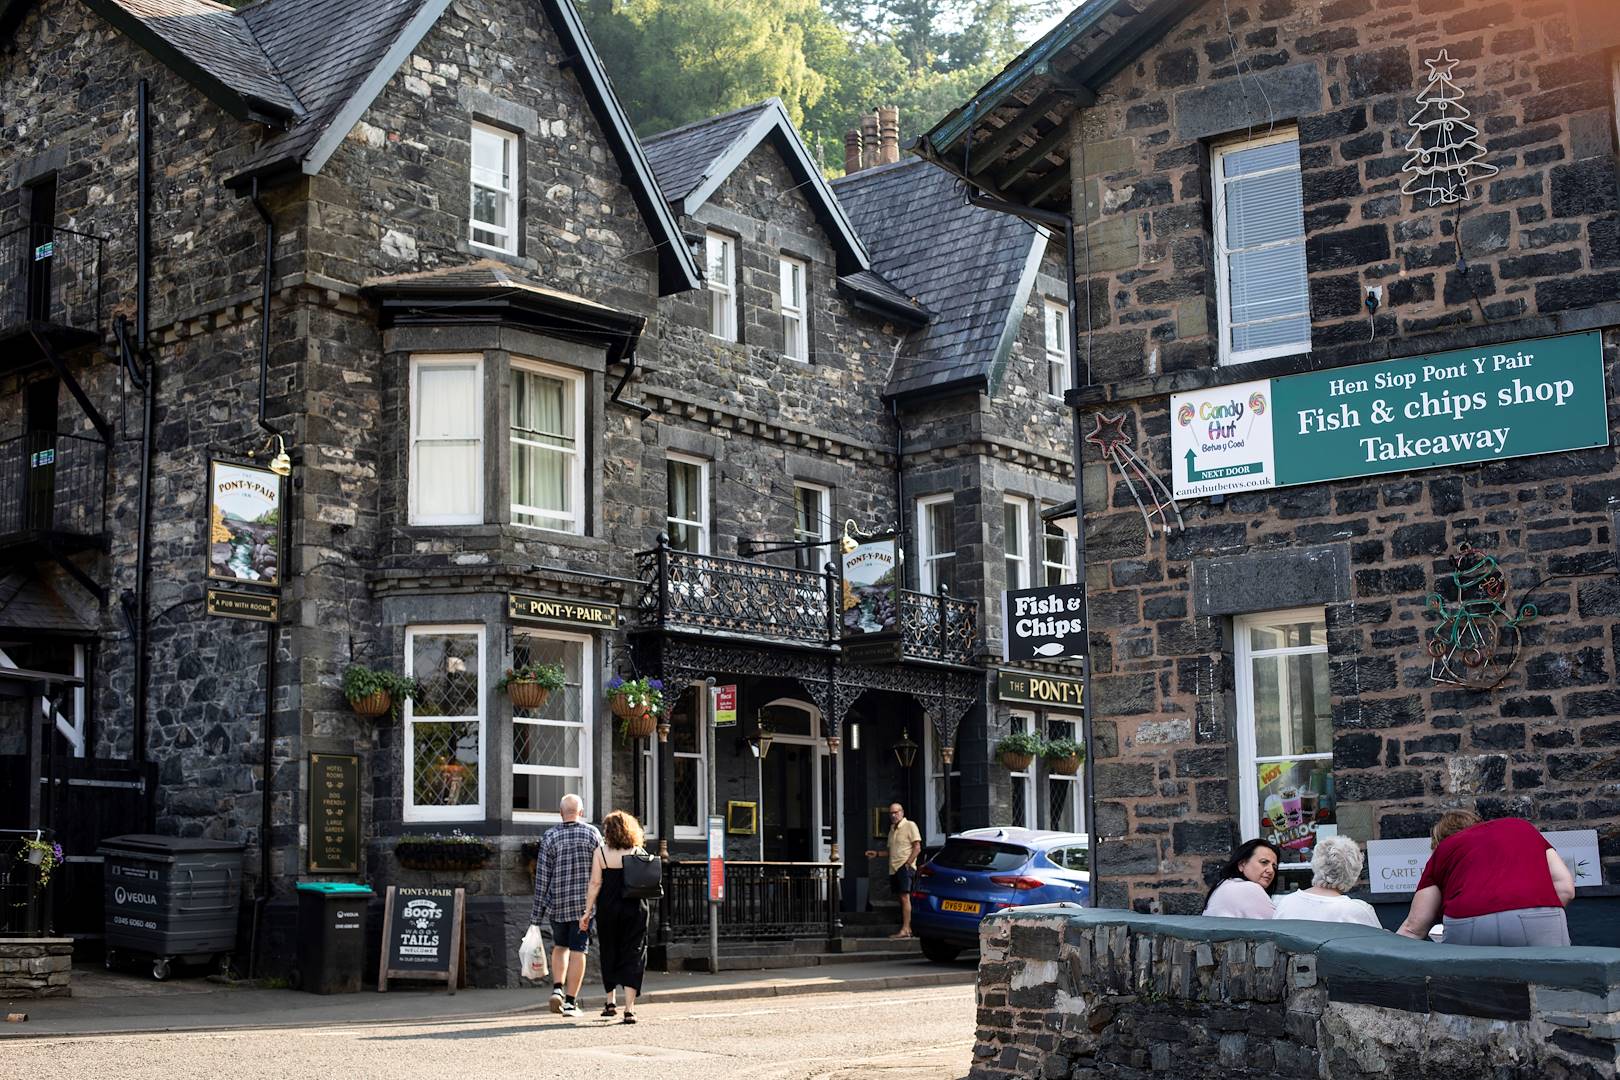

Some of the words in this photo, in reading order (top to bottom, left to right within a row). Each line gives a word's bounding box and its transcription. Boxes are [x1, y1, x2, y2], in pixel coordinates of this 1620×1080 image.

[1329, 378, 1368, 396] Hen
[1374, 371, 1416, 391] Siop
[1422, 362, 1468, 382] Pont
[1472, 357, 1486, 374] Y
[1493, 351, 1534, 372] Pair
[1200, 400, 1244, 421] Candy
[1297, 402, 1361, 435] Fish
[1370, 399, 1395, 424] &
[1404, 390, 1488, 420] chips
[1498, 378, 1574, 406] shop
[1208, 420, 1236, 440] Hut
[1228, 440, 1245, 449] Coed
[1359, 426, 1510, 462] Takeaway
[1201, 469, 1224, 479] NEXT
[1225, 465, 1250, 475] DOOR
[218, 480, 275, 500] PONT-Y-PAIR
[1176, 477, 1271, 496] candyhutbetws.co.uk
[846, 552, 892, 569] PONT-Y-PAIR
[250, 603, 270, 612] ROOMS
[515, 602, 526, 610] THE
[530, 600, 602, 622] PONT-Y-PAIR
[1015, 594, 1064, 616] Fish
[1067, 598, 1081, 611] &
[1016, 617, 1081, 638] Chips
[1010, 681, 1024, 692] THE
[1263, 764, 1282, 784] HOT
[1381, 868, 1416, 880] CARTE
[127, 892, 157, 904] VEOLIA
[400, 887, 452, 896] PONT-Y-PAIR
[404, 907, 442, 918] BOOTS
[401, 934, 439, 946] TAILS
